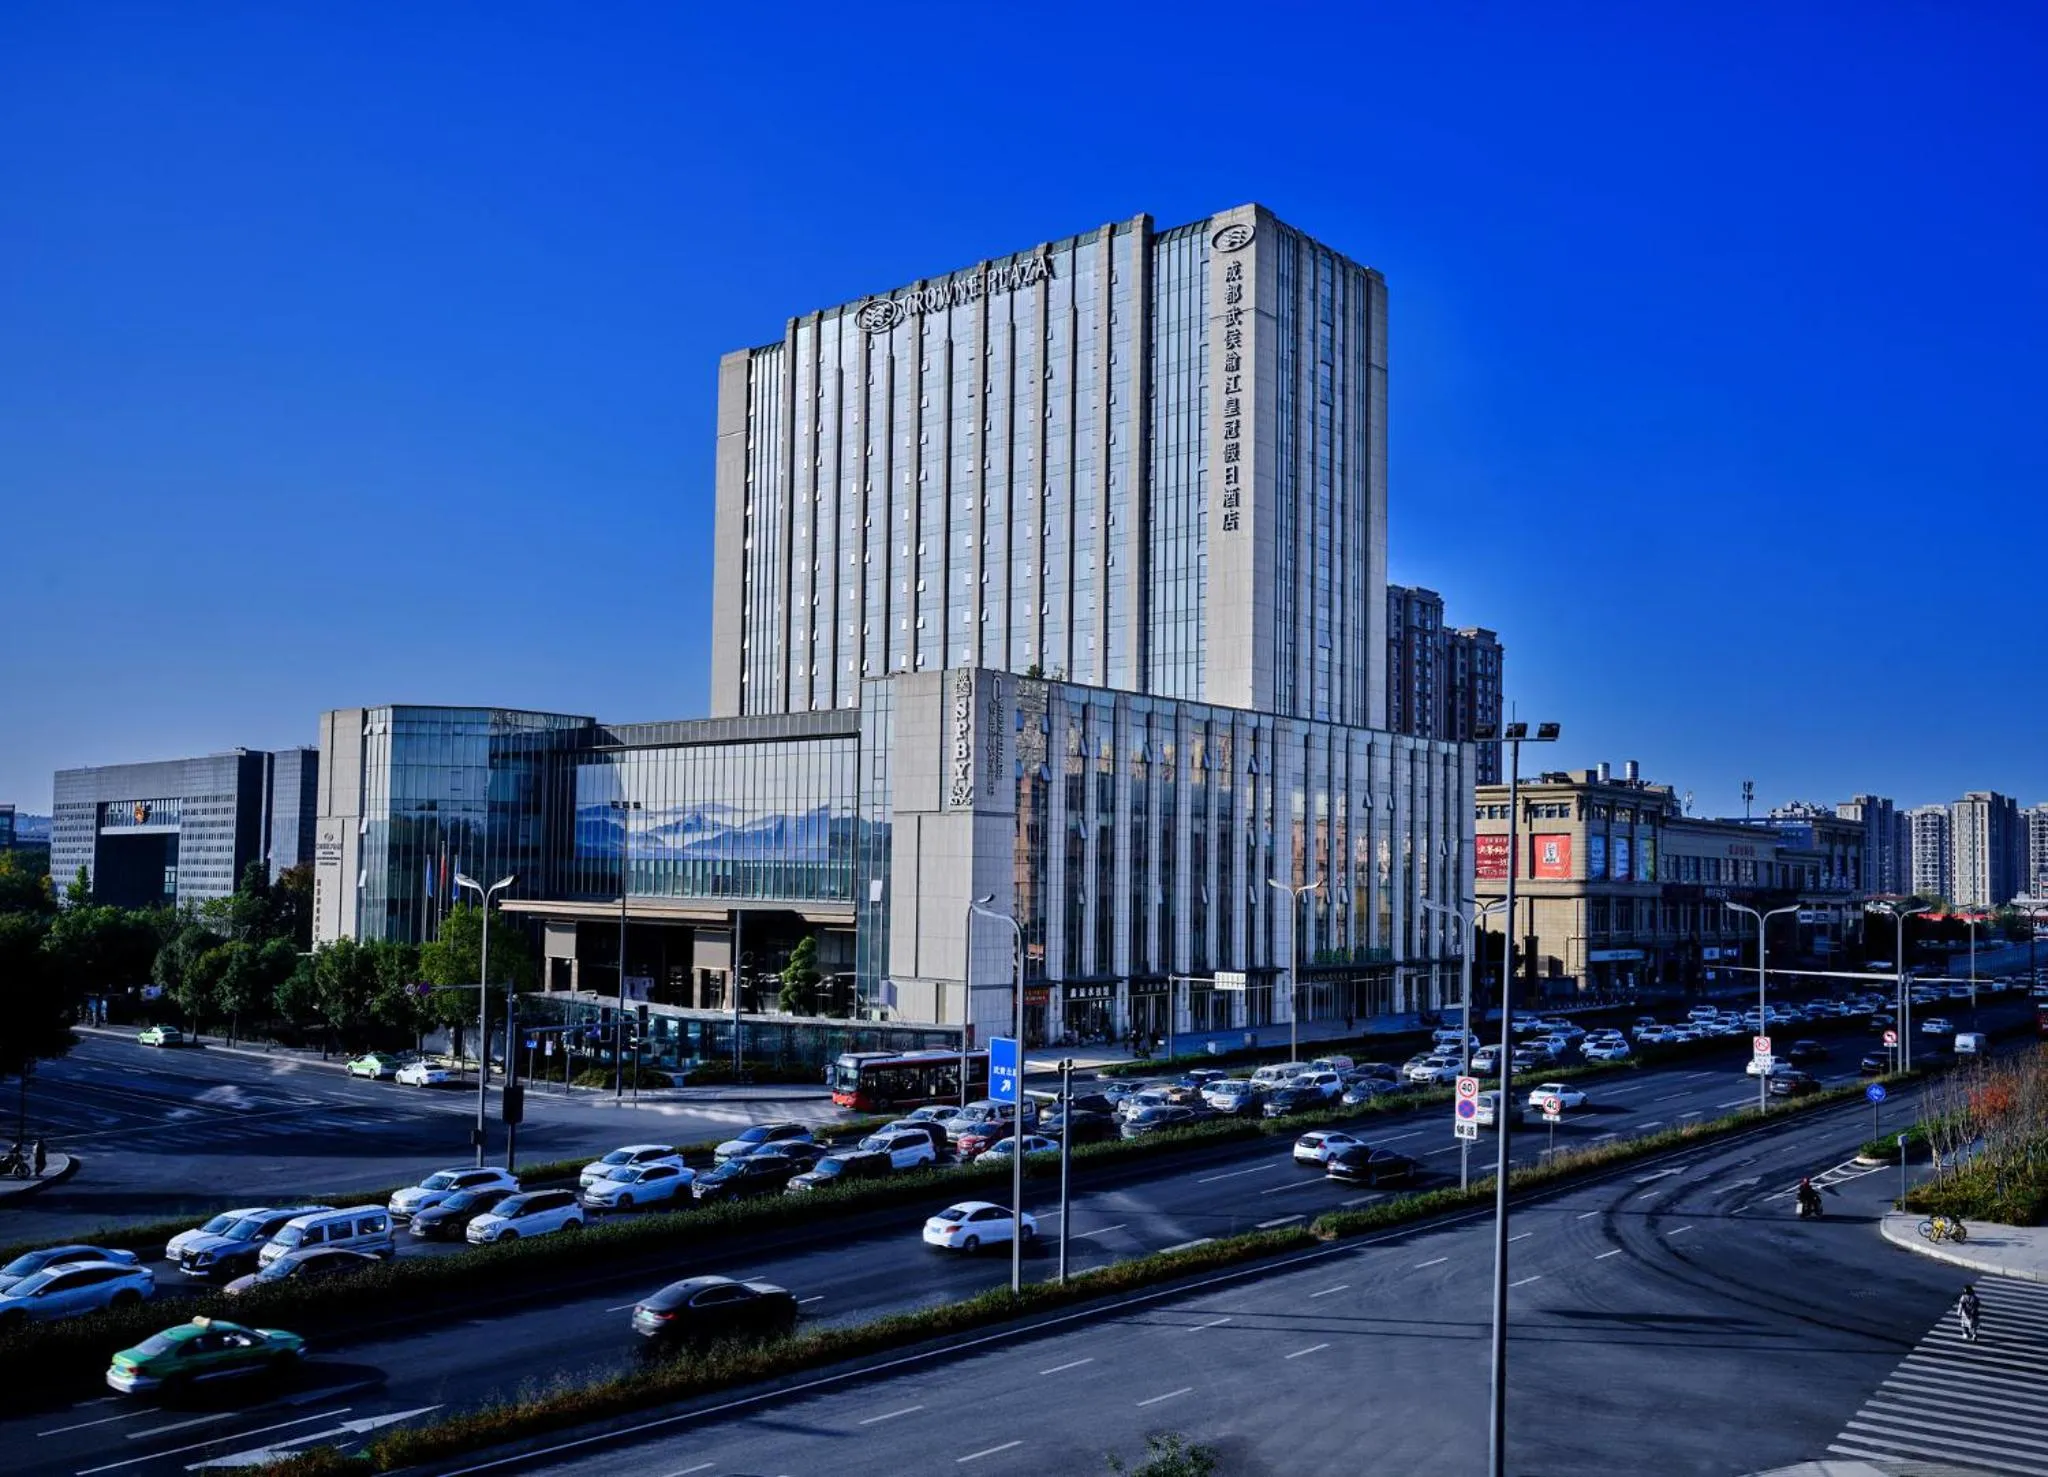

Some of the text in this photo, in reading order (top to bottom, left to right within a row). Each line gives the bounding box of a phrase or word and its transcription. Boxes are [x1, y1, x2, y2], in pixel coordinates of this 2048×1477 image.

[902, 254, 1050, 316] CROWNE PLAZA
[1462, 1083, 1472, 1093] 40
[1547, 1099, 1556, 1110] 40
